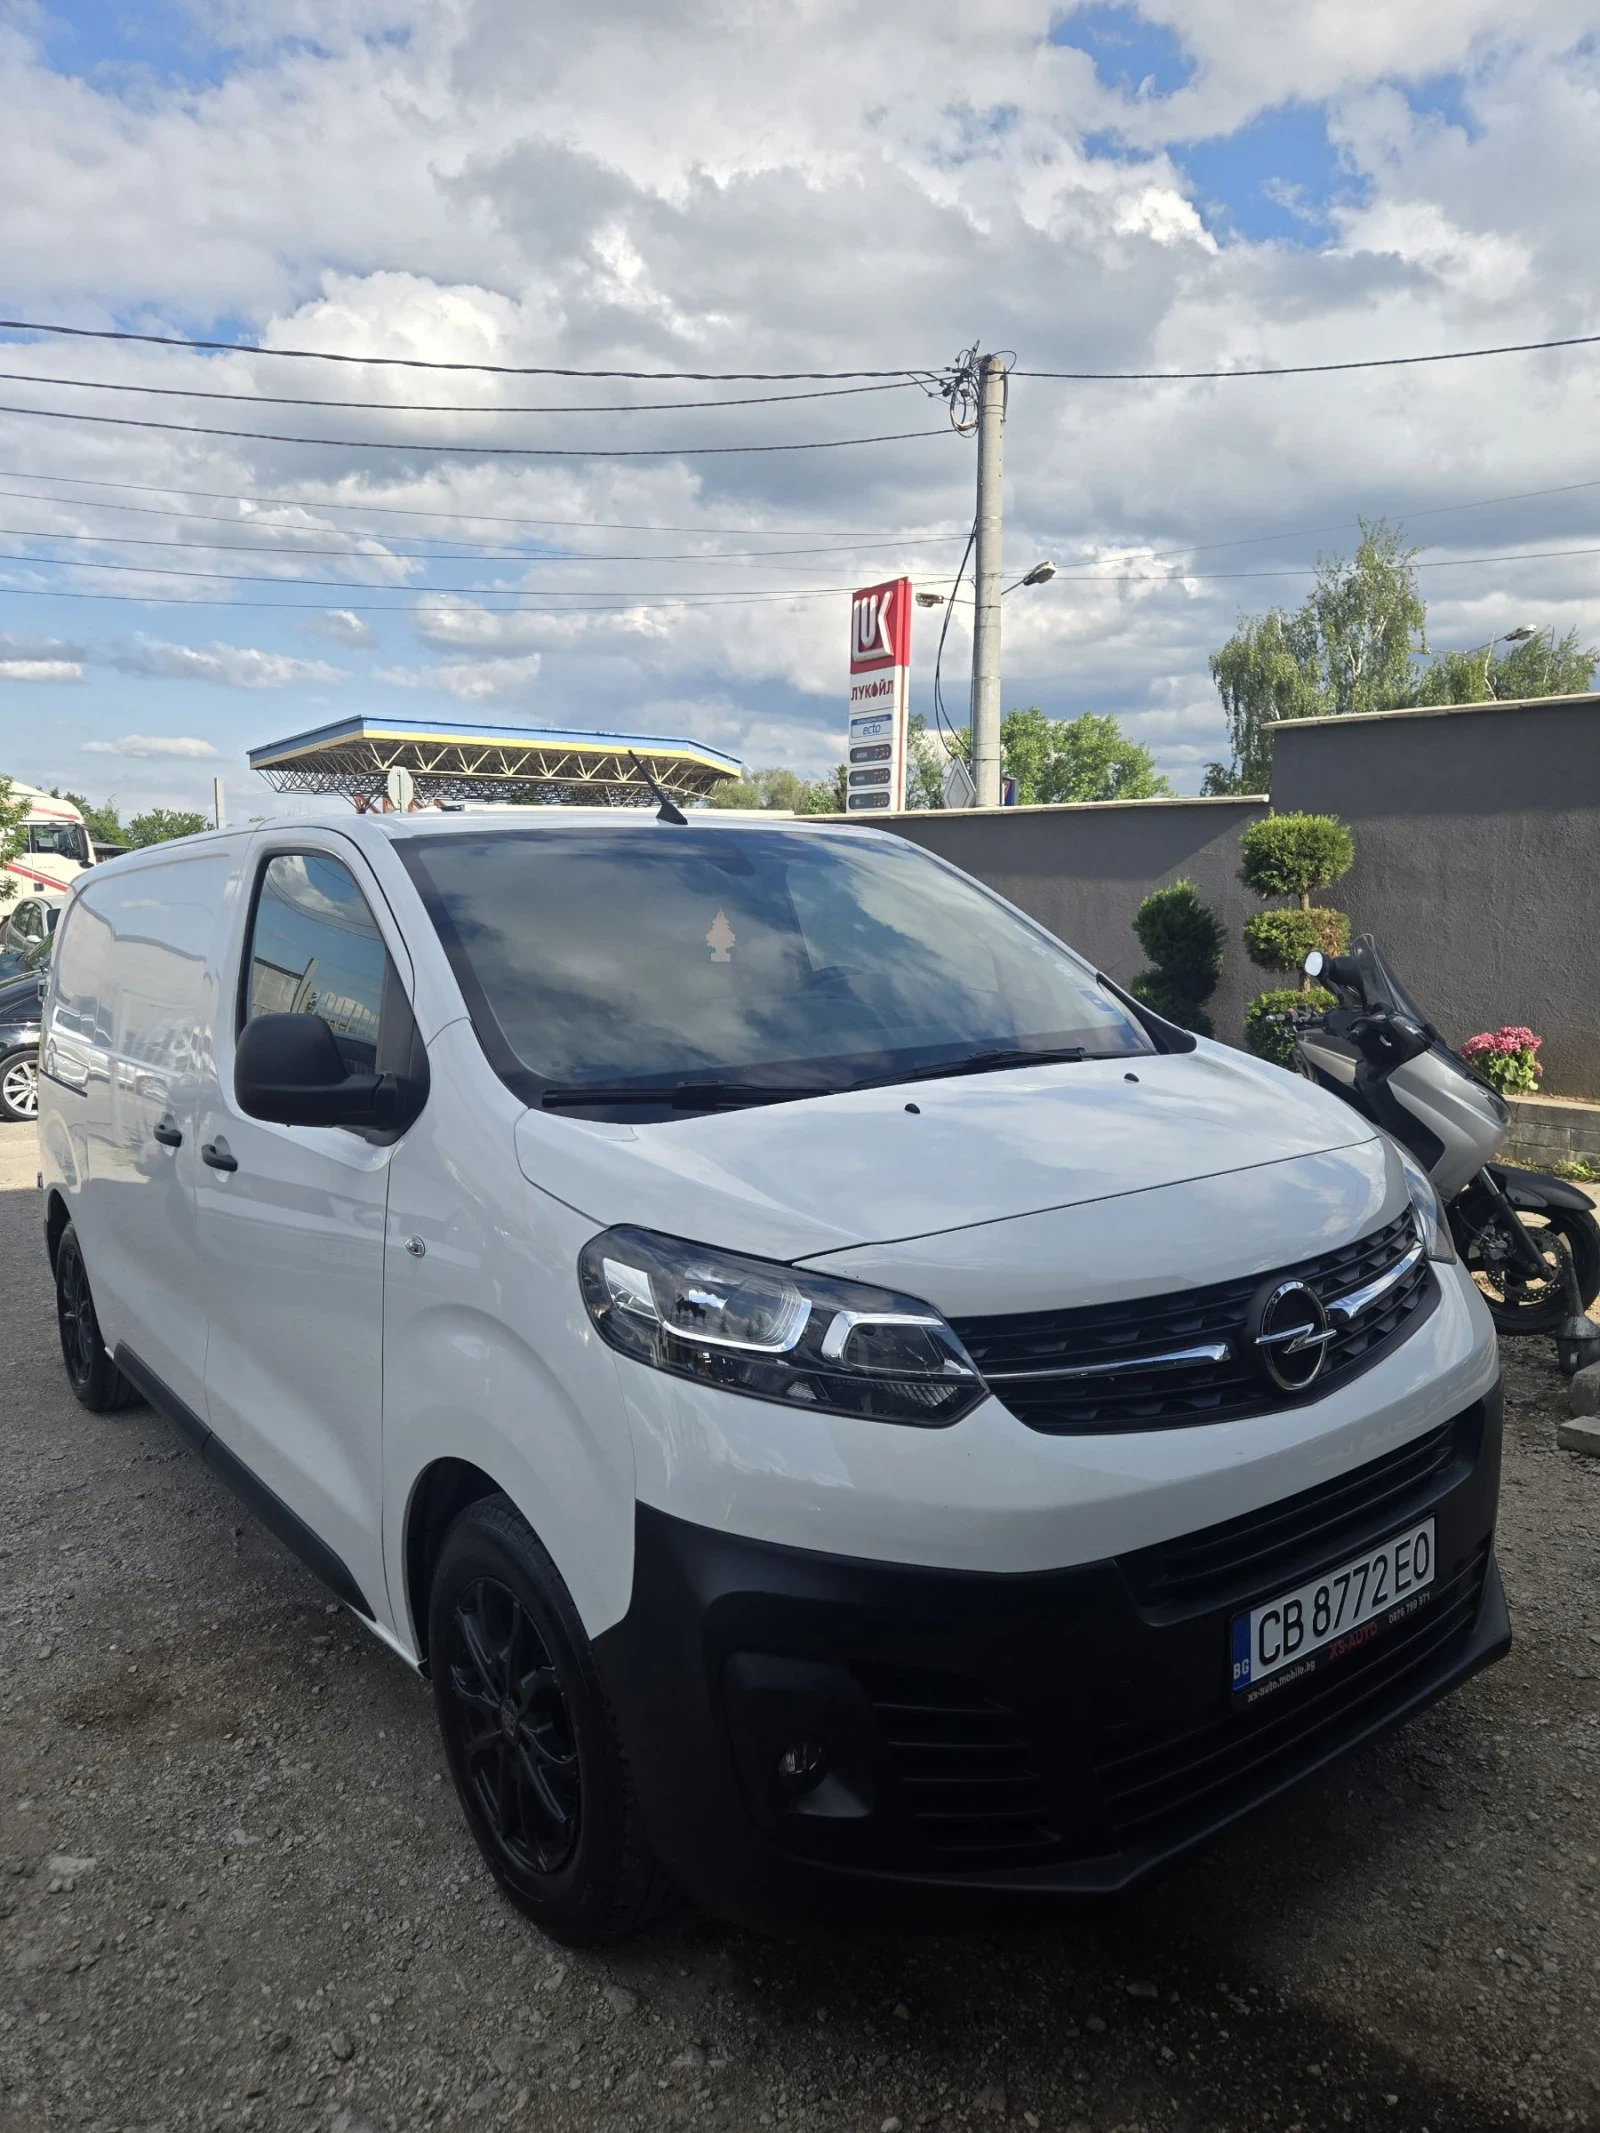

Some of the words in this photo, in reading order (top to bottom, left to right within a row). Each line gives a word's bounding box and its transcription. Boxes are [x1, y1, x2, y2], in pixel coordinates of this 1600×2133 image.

[862, 723, 881, 735] ecto
[1258, 1598, 1305, 1667] CB
[1312, 1554, 1389, 1638] 8772
[1394, 1531, 1430, 1595] EO
[1329, 1621, 1378, 1660] XS-AUTO
[1233, 1658, 1250, 1680] BG
